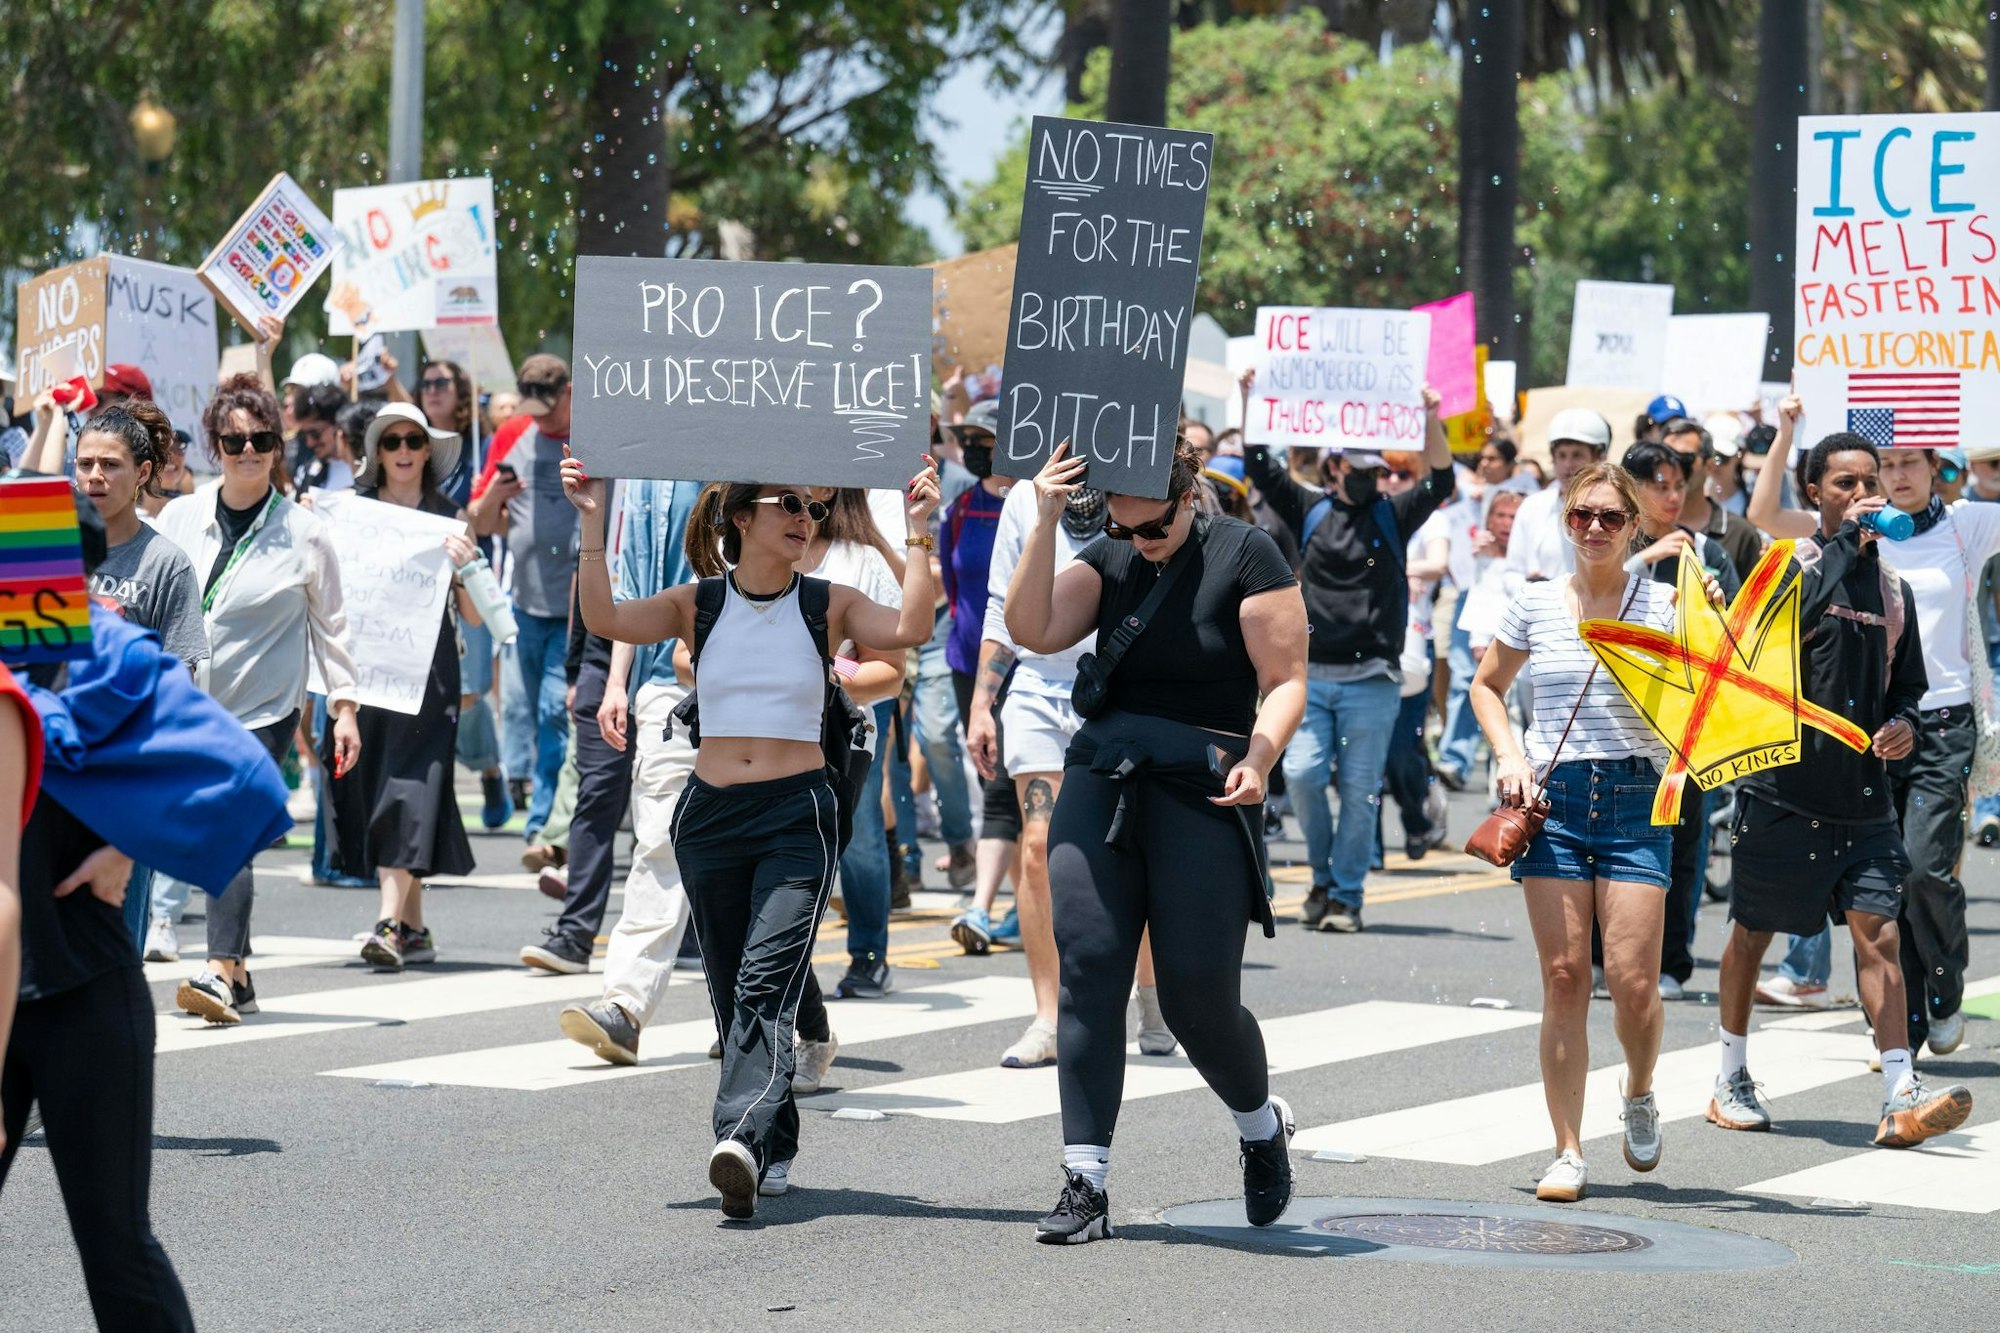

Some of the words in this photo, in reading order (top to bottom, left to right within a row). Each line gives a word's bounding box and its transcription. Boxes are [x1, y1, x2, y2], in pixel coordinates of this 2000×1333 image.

[1038, 129, 1101, 182] NO
[1105, 133, 1208, 191] TIMES
[1813, 127, 1976, 218] ICE
[1049, 212, 1118, 262] FOR
[1127, 219, 1192, 267] THE
[1812, 215, 1996, 276] MELTS
[36, 275, 79, 335] NO
[106, 274, 209, 327] MUSK
[638, 280, 725, 338] PRO
[1801, 276, 1940, 327] FASTER
[1016, 292, 1185, 370] BIRTHDAY
[1267, 315, 1311, 351] ICE
[1320, 317, 1364, 354] WILL
[1383, 319, 1409, 356] BE
[1798, 330, 2000, 371] CALIFORNIA
[584, 353, 652, 400] YOU
[664, 354, 816, 409] DESERVE
[1269, 356, 1377, 391] REMEMBERED
[1388, 364, 1413, 391] AS
[1008, 383, 1160, 468] BITCH
[1264, 398, 1325, 434] THUGS
[97, 574, 149, 604] DAY
[1698, 768, 1723, 790] NO
[1731, 746, 1797, 776] KINGS
